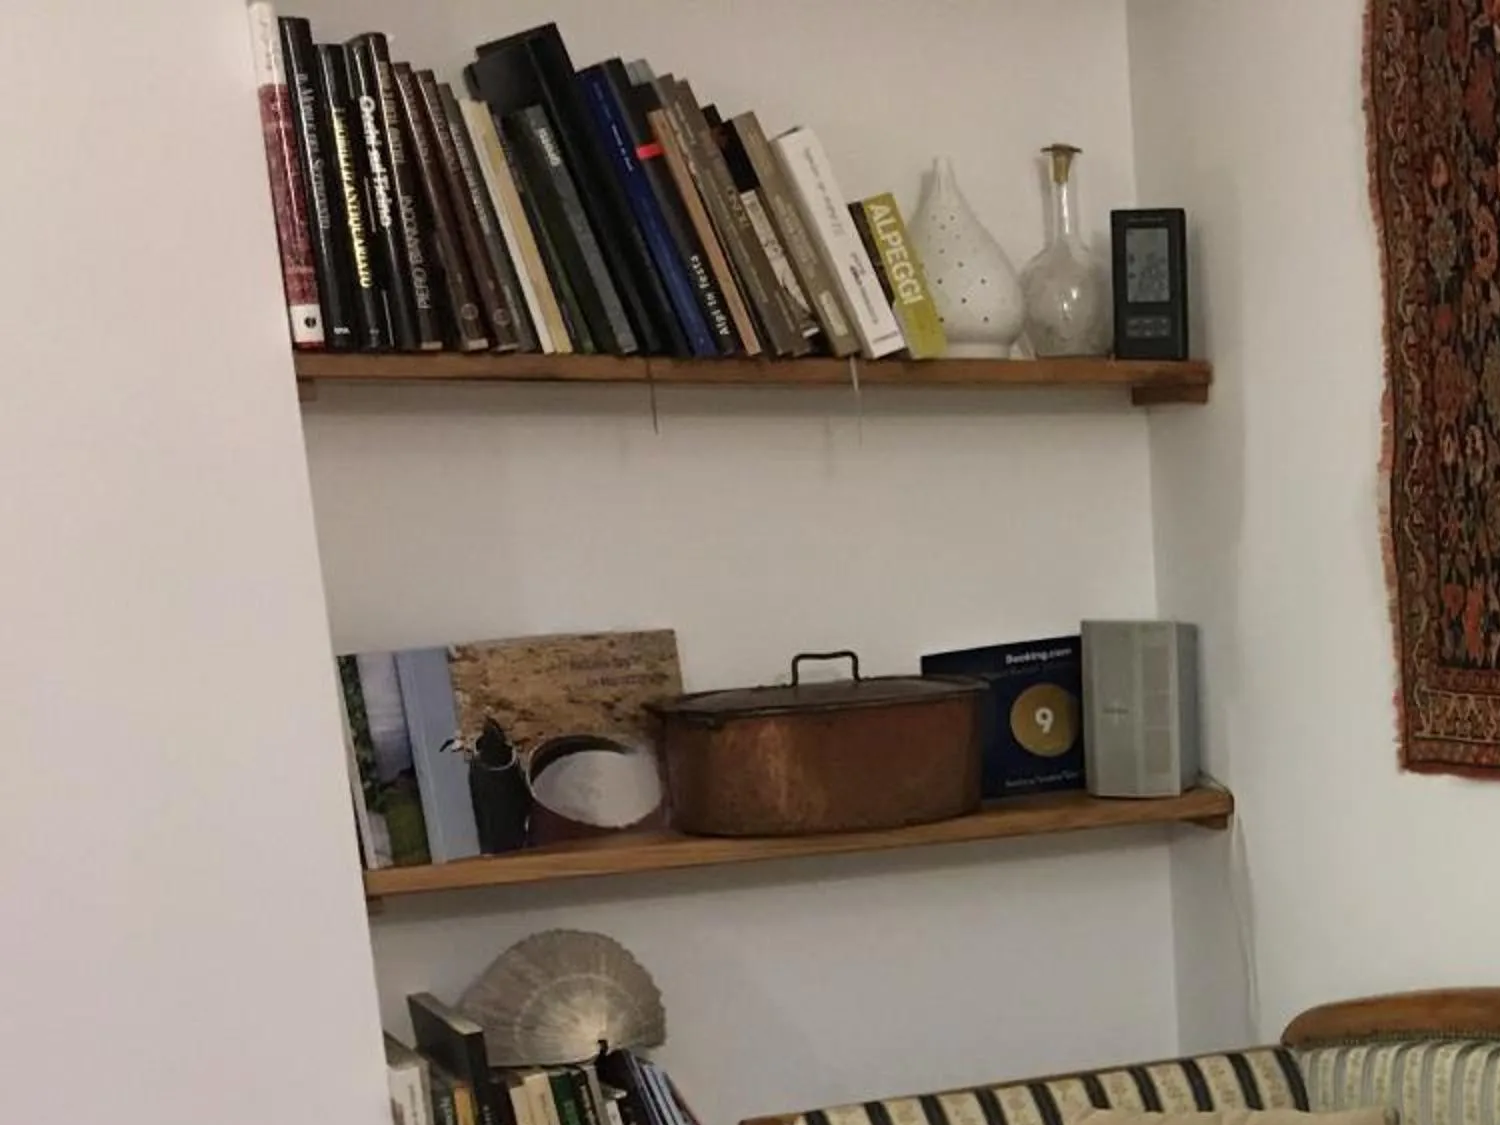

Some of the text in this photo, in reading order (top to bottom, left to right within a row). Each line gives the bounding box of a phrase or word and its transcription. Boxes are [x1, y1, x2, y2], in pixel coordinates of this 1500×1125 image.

[868, 204, 924, 305] ALPEGGI
[1004, 647, 1073, 666] Booking.com
[1035, 707, 1055, 734] 9
